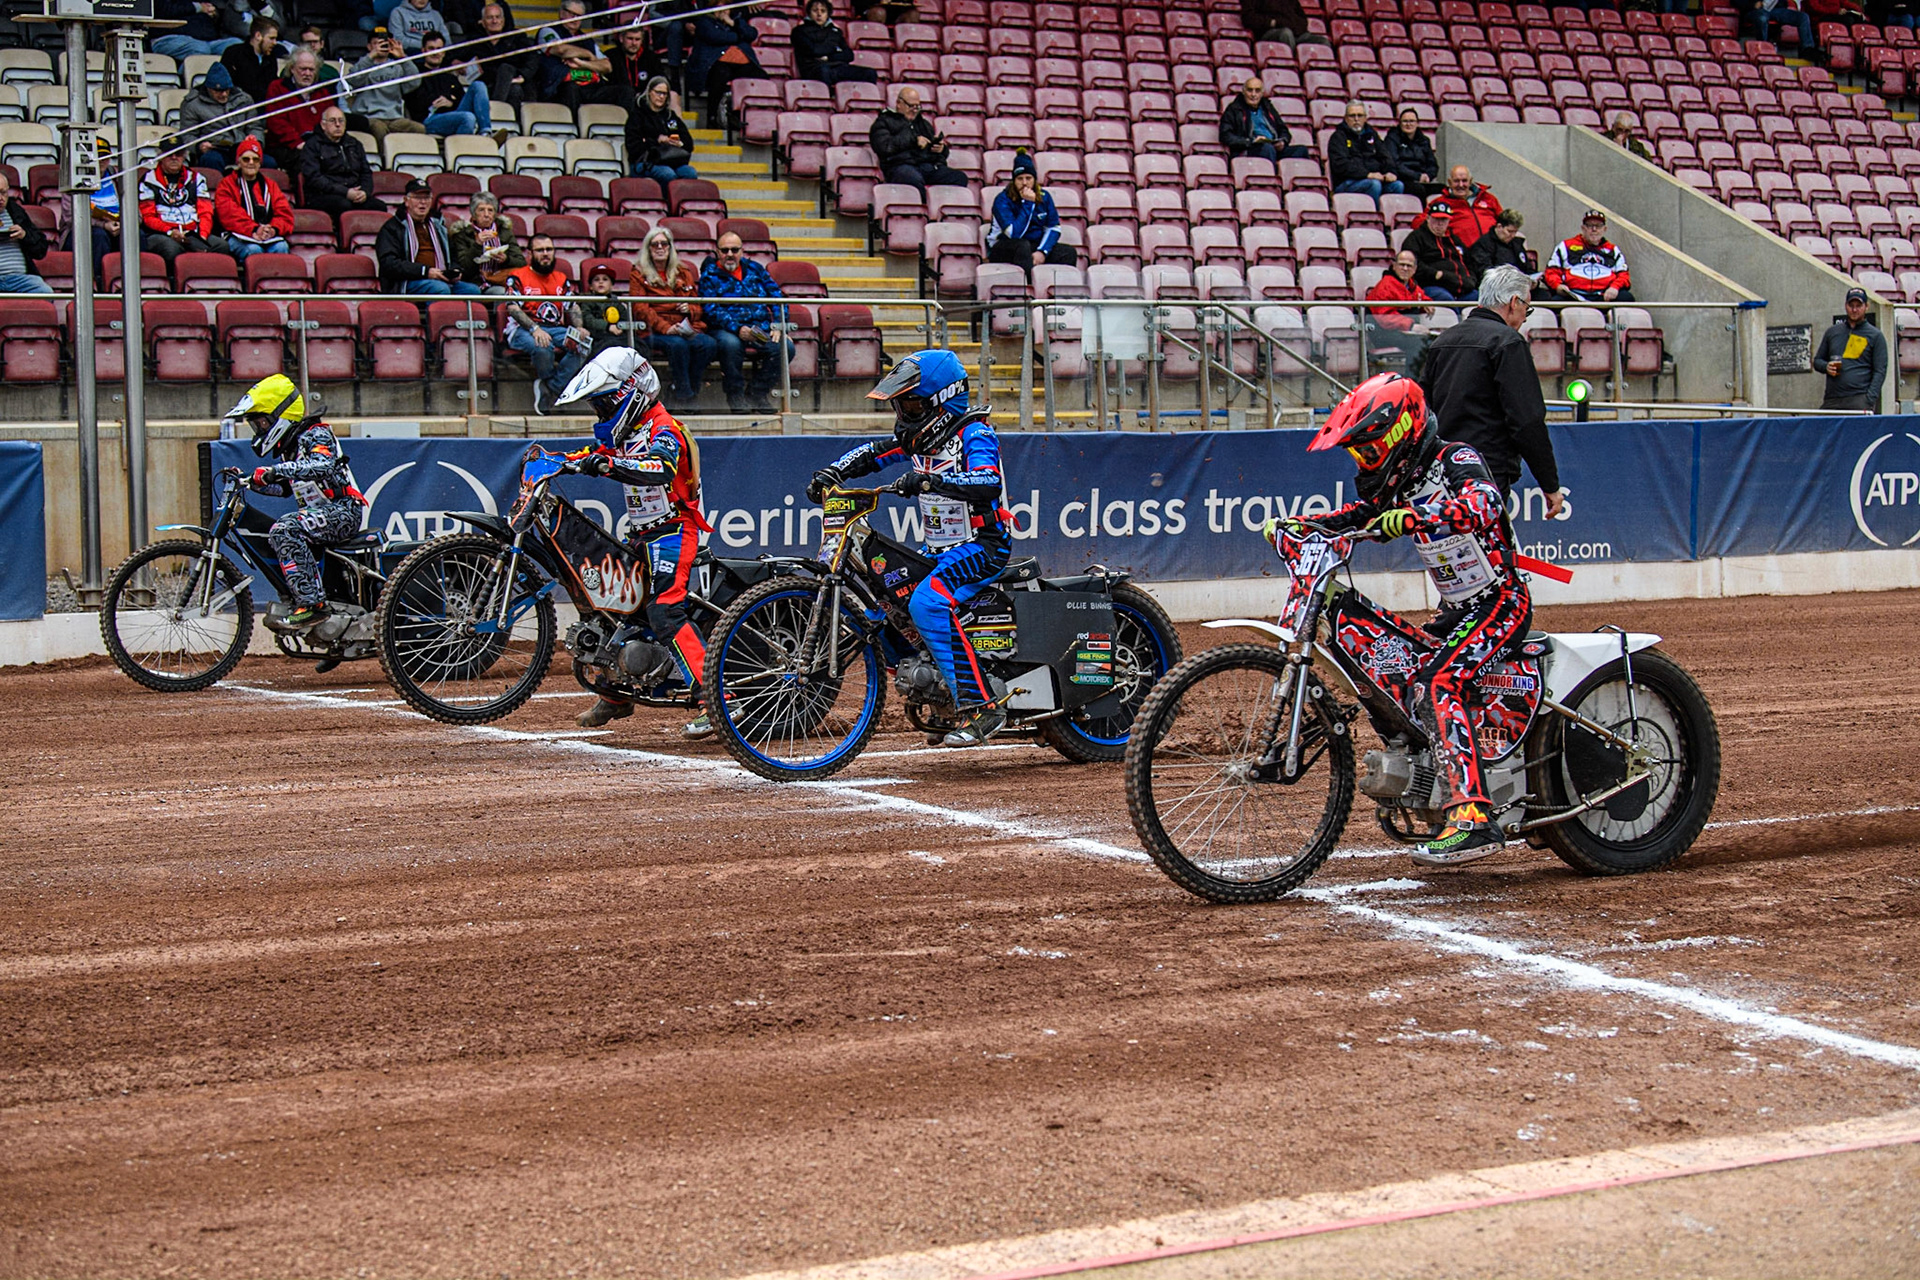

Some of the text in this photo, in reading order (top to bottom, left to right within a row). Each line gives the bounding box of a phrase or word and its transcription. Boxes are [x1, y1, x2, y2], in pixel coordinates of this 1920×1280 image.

[930, 379, 965, 407] 100%
[1382, 411, 1412, 449] 100
[948, 440, 961, 451] 91
[1865, 472, 1920, 506] ATP
[1058, 488, 1187, 538] class
[1204, 480, 1344, 533] travel
[1294, 542, 1328, 576] 367
[1523, 539, 1612, 564] atpi.com
[1066, 602, 1112, 610] OLLIE BINNS
[1080, 674, 1109, 683] MOTOREX
[1479, 687, 1527, 697] SPEEDWAY
